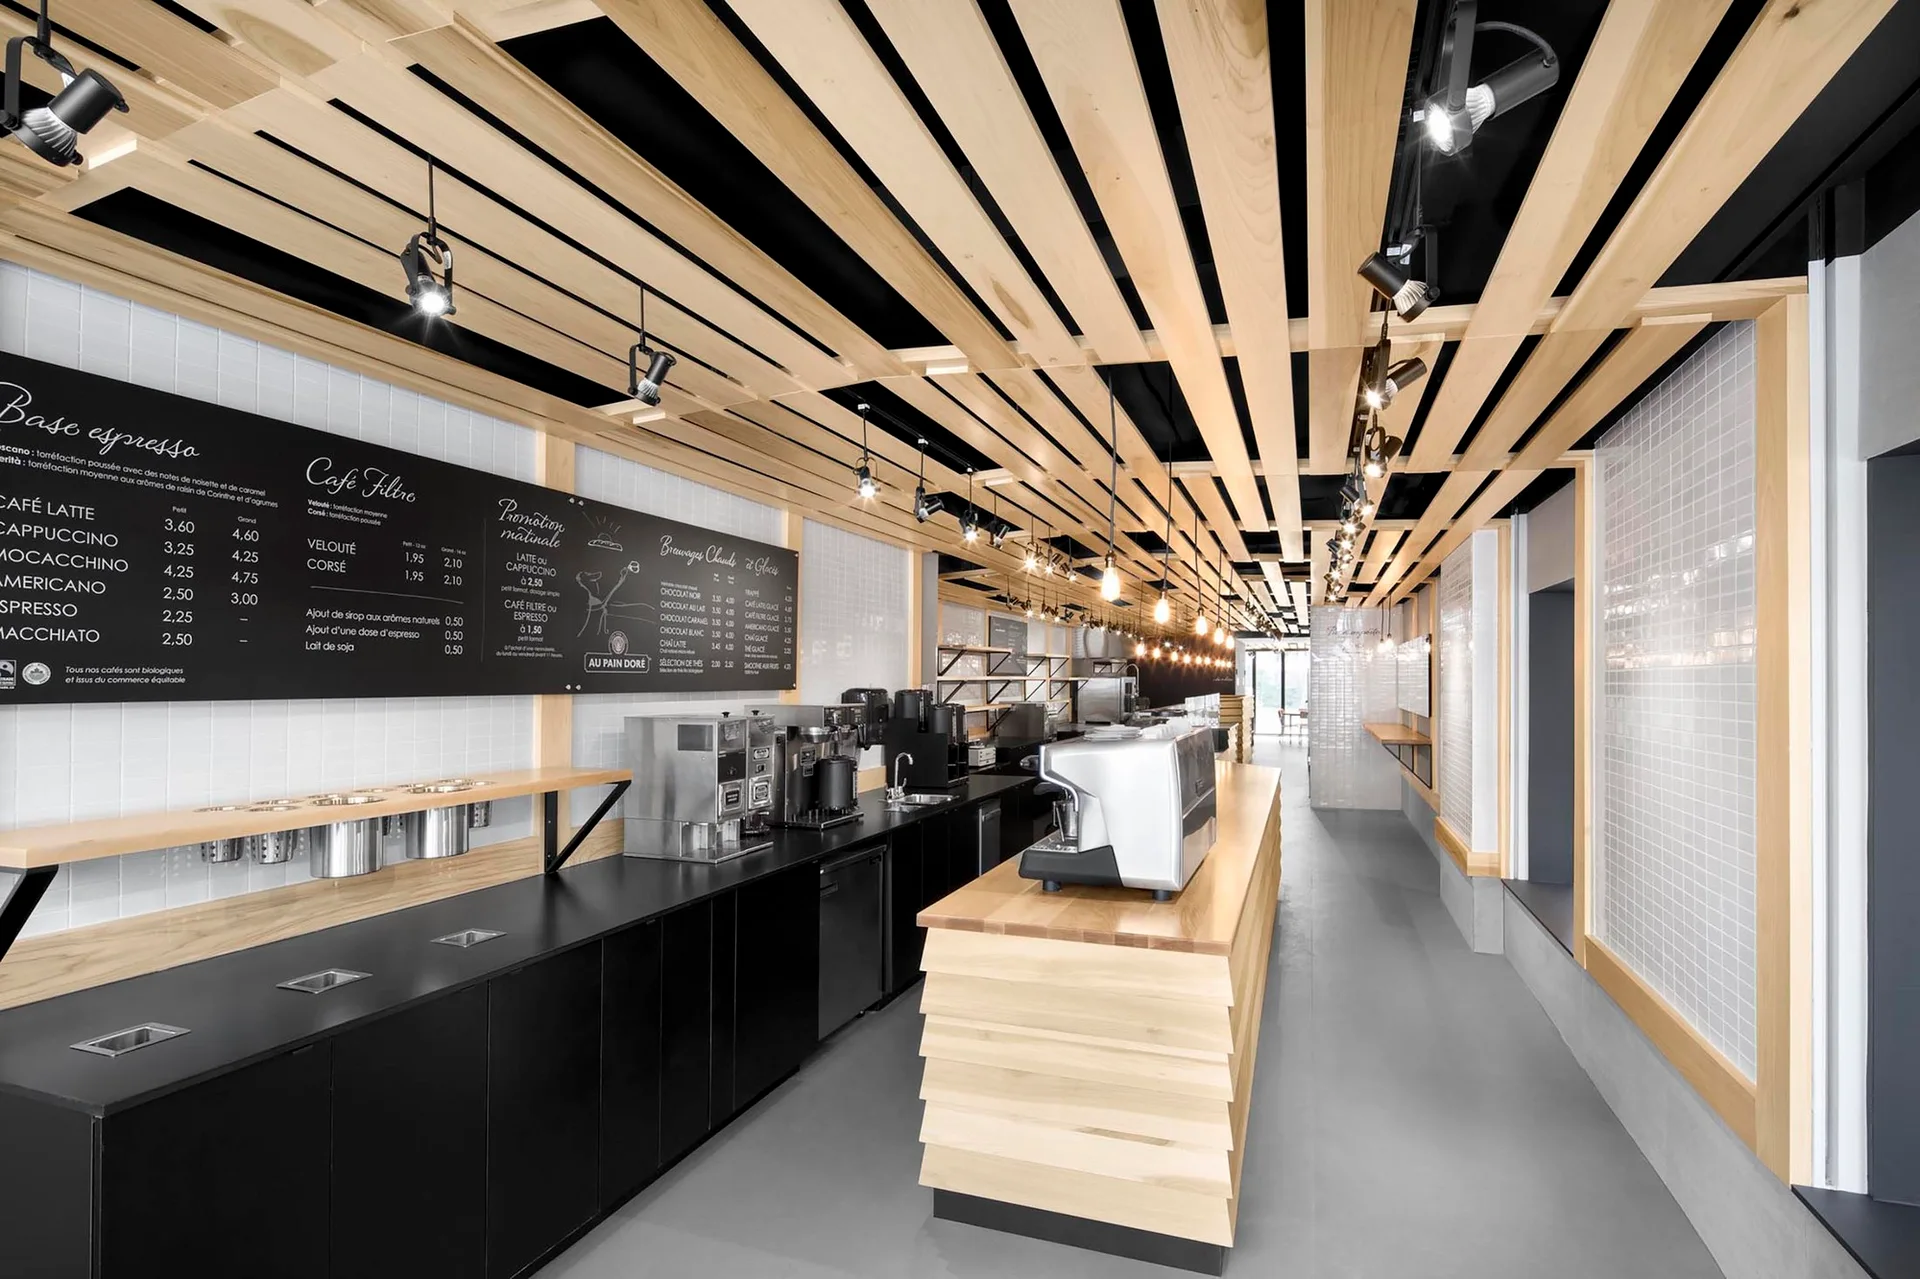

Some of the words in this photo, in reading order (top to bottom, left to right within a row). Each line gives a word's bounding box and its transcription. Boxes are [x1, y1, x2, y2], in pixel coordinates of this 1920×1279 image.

[0, 381, 80, 436] Base
[88, 426, 200, 459] espresso
[36, 450, 86, 465] torréfaction
[88, 460, 121, 471] poussée
[122, 465, 143, 476] avec
[144, 469, 158, 478] des
[159, 472, 180, 482] notes
[180, 475, 191, 484] de
[192, 478, 219, 489] noisette
[220, 481, 228, 490] et
[228, 483, 238, 492] de
[238, 486, 266, 497] caramel
[306, 456, 359, 495] Café
[361, 467, 416, 503] Filtre
[28, 460, 79, 475] torréfaction
[80, 469, 119, 481] moyenne
[120, 475, 135, 484] aux
[136, 477, 164, 489] arômes
[165, 481, 176, 491] de
[177, 484, 195, 494] raisin
[196, 487, 206, 496] de
[206, 489, 236, 501] Corinthe
[236, 493, 244, 502] et
[244, 495, 279, 508] d'agrumes
[172, 506, 187, 514] Petit
[307, 498, 330, 509] Velouté
[47, 501, 95, 520] LATTE
[307, 507, 326, 517] Corsé
[498, 498, 566, 533] Promotion
[164, 518, 195, 533] 3,60
[237, 516, 257, 524] Grand
[232, 528, 259, 542] 4,60
[500, 526, 561, 548] matinale
[164, 541, 194, 556] 3,25
[307, 538, 357, 555] VELOUTÉ
[232, 550, 259, 563] 4,25
[405, 551, 424, 564] 1,95
[516, 552, 537, 564] LATTE
[537, 557, 548, 565] ou
[705, 544, 737, 568] Chauds
[306, 558, 347, 573] CORSÉ
[444, 557, 463, 569] 2,10
[505, 561, 557, 578] CAPPUCCINO
[163, 565, 194, 578] 4,25
[231, 571, 259, 584] 4,75
[405, 569, 424, 582] 1,95
[0, 574, 106, 594] MERICANO
[443, 574, 463, 586] 2,10
[520, 577, 527, 586] à
[527, 577, 543, 587] 2,50
[163, 587, 194, 601] 2,50
[230, 592, 258, 606] 3,00
[660, 587, 688, 598] CHOCOLAT
[688, 591, 701, 601] NOIR
[504, 599, 525, 610] CAFÉ
[526, 601, 547, 612] FILTRE
[547, 605, 557, 613] ou
[660, 600, 688, 611] CHOCOLAT
[162, 609, 193, 624] 2,25
[306, 608, 330, 620] Ajout
[331, 610, 344, 619] de
[345, 610, 365, 622] sirop
[366, 613, 381, 621] aux
[382, 613, 411, 624] arômes
[412, 615, 440, 625] naturels
[445, 616, 464, 627] 0,50
[513, 611, 549, 623] ESPRESSO
[660, 613, 687, 623] CHOCOLAT
[0, 626, 100, 643] ACCHIATO
[306, 625, 330, 636] Ajout
[331, 626, 357, 636] d'une
[358, 626, 379, 636] dose
[380, 628, 420, 640] d'espresso
[444, 630, 464, 641] 0,50
[520, 624, 526, 633] à
[527, 625, 543, 635] 1,50
[660, 626, 688, 636] CHOCOLAT
[688, 629, 704, 637] BLANC
[162, 632, 193, 646] 2,50
[673, 640, 687, 648] LATTE
[305, 641, 322, 651] Lait
[322, 641, 336, 651] de
[337, 642, 355, 653] soja
[444, 644, 463, 655] 0,50
[588, 658, 601, 667] AU
[602, 658, 623, 668] PAIN
[624, 657, 646, 669] DORÉ
[65, 666, 84, 674] Tous
[100, 666, 124, 674] cafés
[142, 666, 184, 675] biologiques
[65, 676, 74, 684] et
[75, 676, 93, 684] issus
[94, 676, 106, 684] du
[151, 676, 186, 685] équitable
